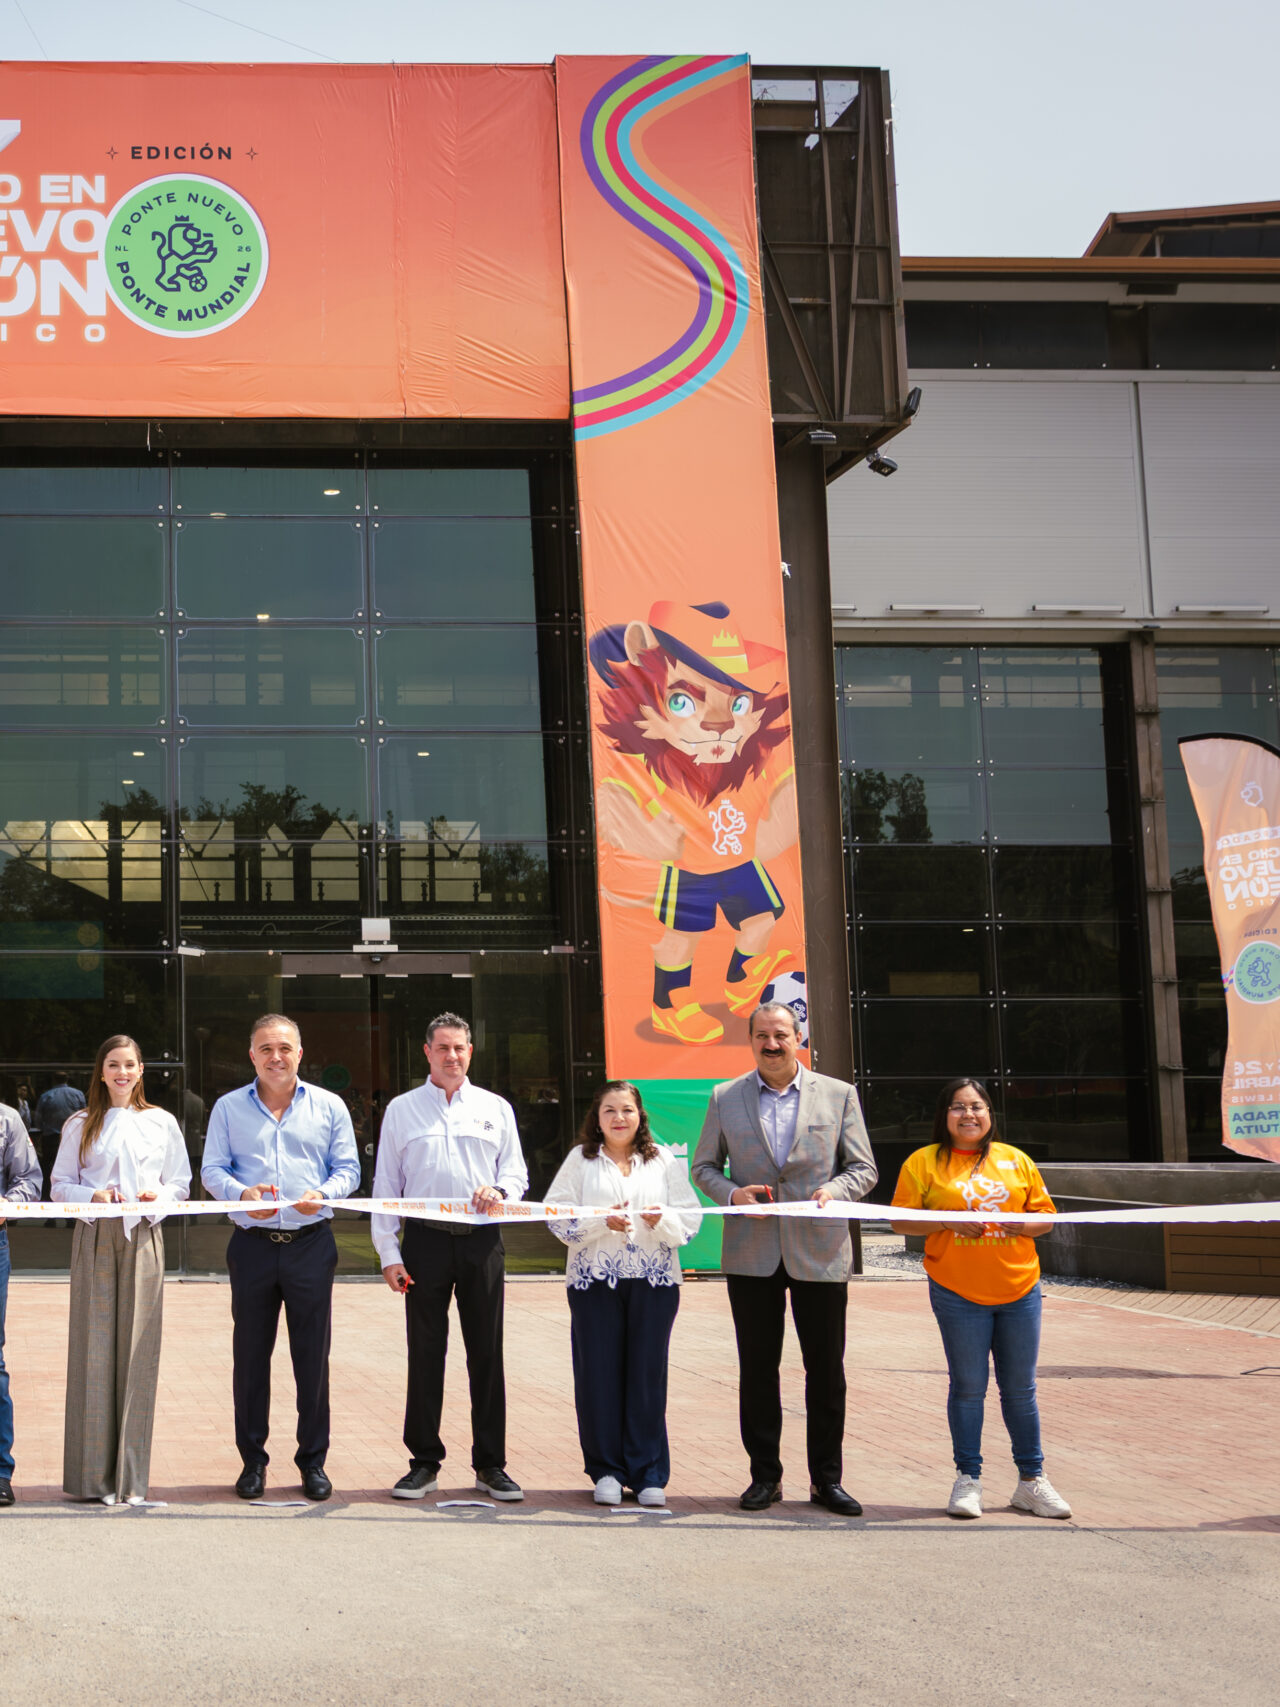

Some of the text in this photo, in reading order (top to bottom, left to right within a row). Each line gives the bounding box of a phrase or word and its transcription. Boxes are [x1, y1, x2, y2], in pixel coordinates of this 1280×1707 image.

[130, 143, 233, 161] EDICIÓN
[39, 173, 107, 204] EN
[121, 192, 244, 236] PONTE NUEVO
[116, 261, 251, 322] PONTE MUNDIAL
